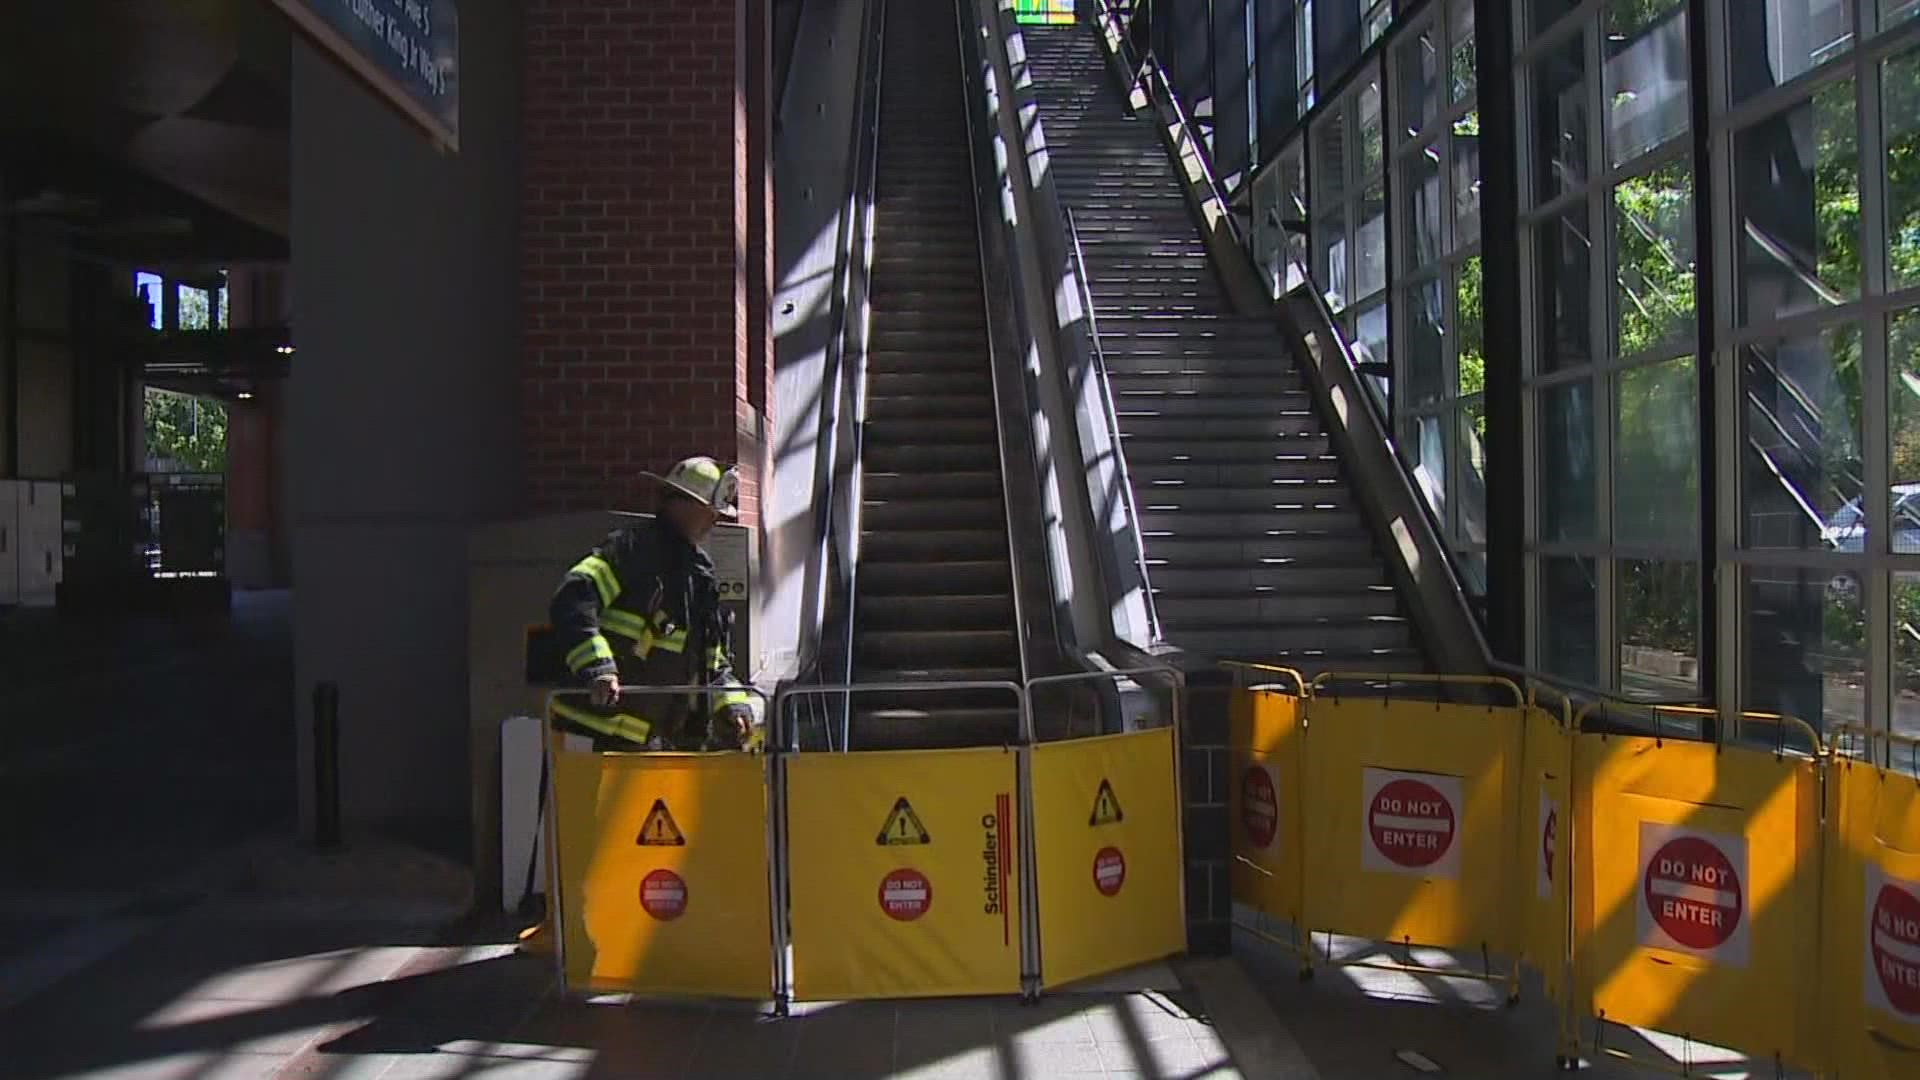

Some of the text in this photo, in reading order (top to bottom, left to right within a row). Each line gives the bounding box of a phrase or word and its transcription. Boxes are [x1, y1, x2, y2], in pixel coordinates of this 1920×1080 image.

[423, 6, 430, 36] S
[387, 13, 408, 69] King
[419, 46, 438, 97] Way
[438, 64, 446, 95] S
[1381, 798, 1442, 816] DO NOT
[1383, 831, 1438, 848] ENTER
[886, 880, 922, 889] DO NOT
[983, 831, 998, 914] Schindler
[1660, 859, 1728, 885] DO NOT
[1663, 899, 1722, 928] ENTER
[1894, 917, 1920, 938] NO
